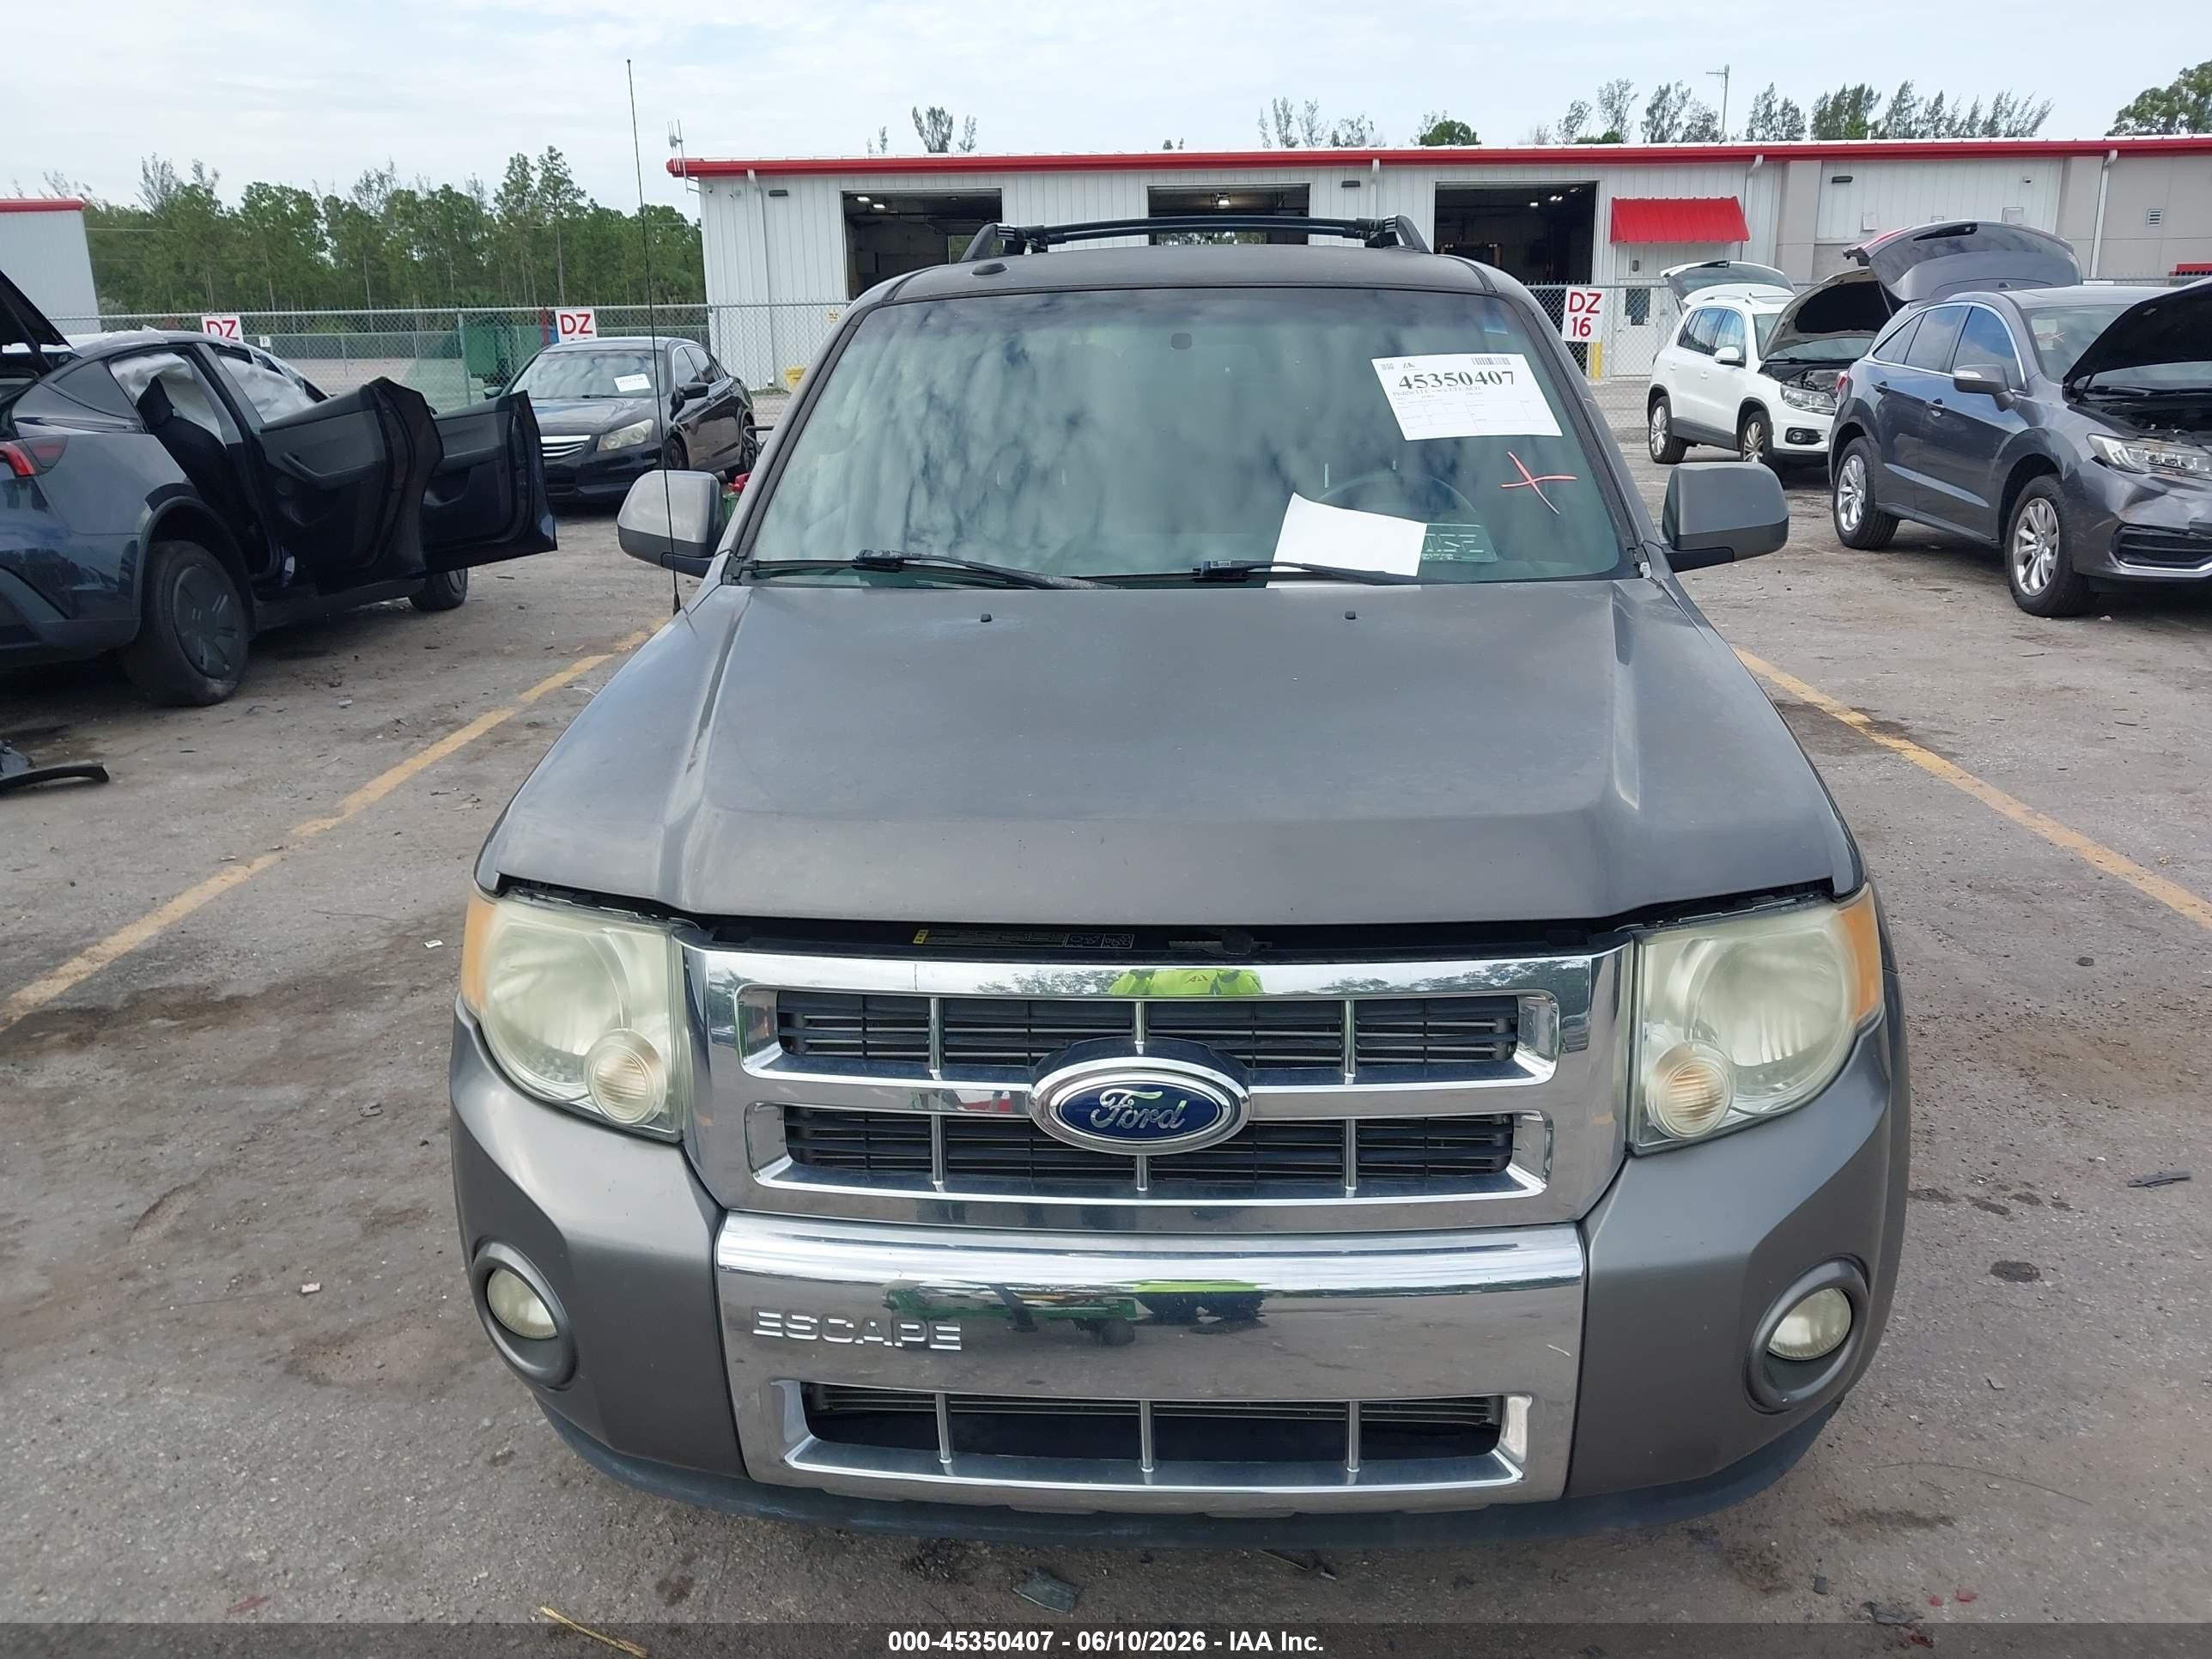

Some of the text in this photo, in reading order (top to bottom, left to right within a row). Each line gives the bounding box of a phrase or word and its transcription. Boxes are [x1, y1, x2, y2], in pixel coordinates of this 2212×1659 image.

[1569, 292, 1602, 314] DZ
[206, 319, 240, 340] DZ
[560, 313, 593, 335] DZ
[1571, 316, 1591, 337] 16
[1399, 370, 1514, 390] 45350407
[1090, 1088, 1188, 1129] Ford
[752, 1309, 962, 1351] ESCAPE
